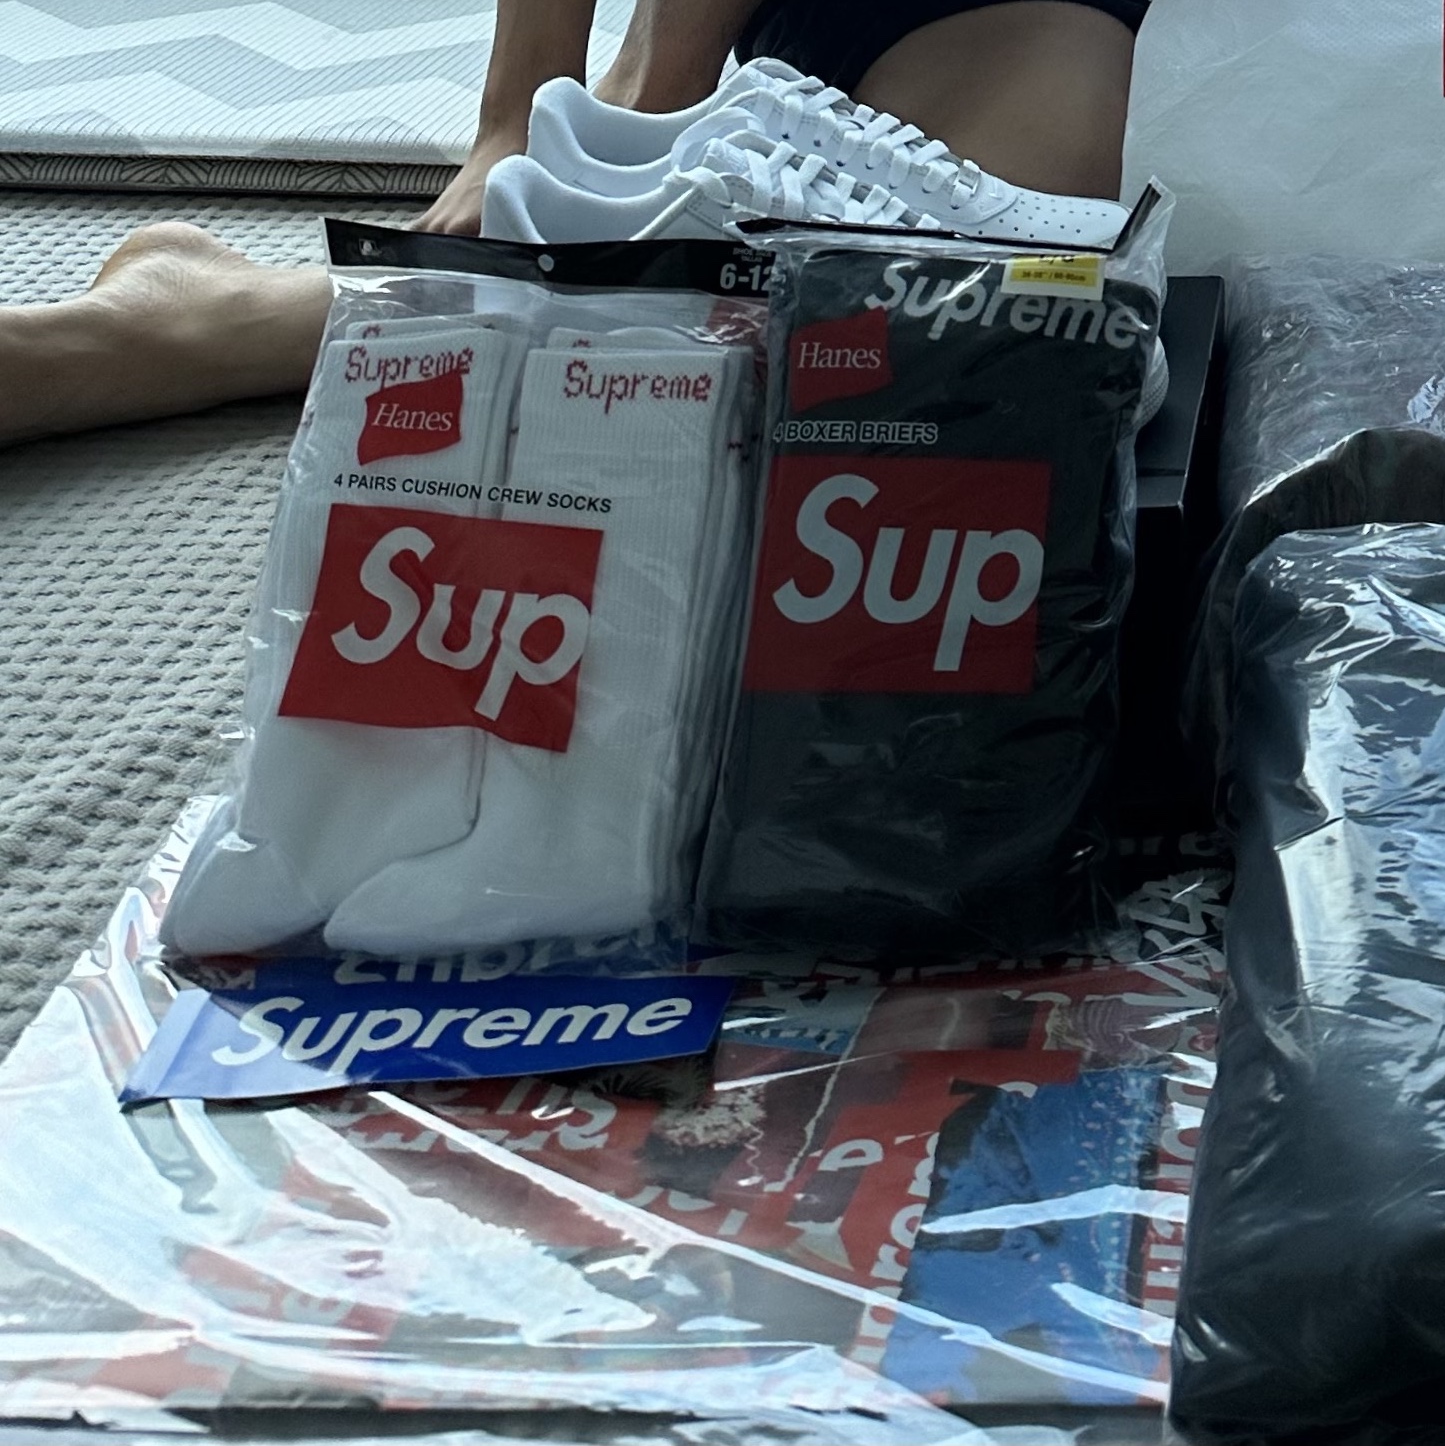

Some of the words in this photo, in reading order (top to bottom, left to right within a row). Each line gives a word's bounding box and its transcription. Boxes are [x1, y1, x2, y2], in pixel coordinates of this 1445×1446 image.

[864, 259, 1142, 350] Supreme
[344, 345, 474, 390] Supreme
[796, 342, 881, 369] Hanes
[564, 360, 712, 415] Supreme
[371, 403, 453, 432] Hanes
[772, 422, 784, 443] 4
[785, 420, 856, 442] BOXER
[860, 421, 938, 444] BRIEFS
[334, 473, 344, 487] 4
[348, 474, 397, 492] PAIRS
[402, 478, 483, 500] CUSHION
[487, 486, 543, 505] CREW
[546, 492, 612, 513] SOCKS
[772, 474, 1045, 672] Sup
[331, 526, 591, 721] Sup
[212, 996, 692, 1076] Supreme
